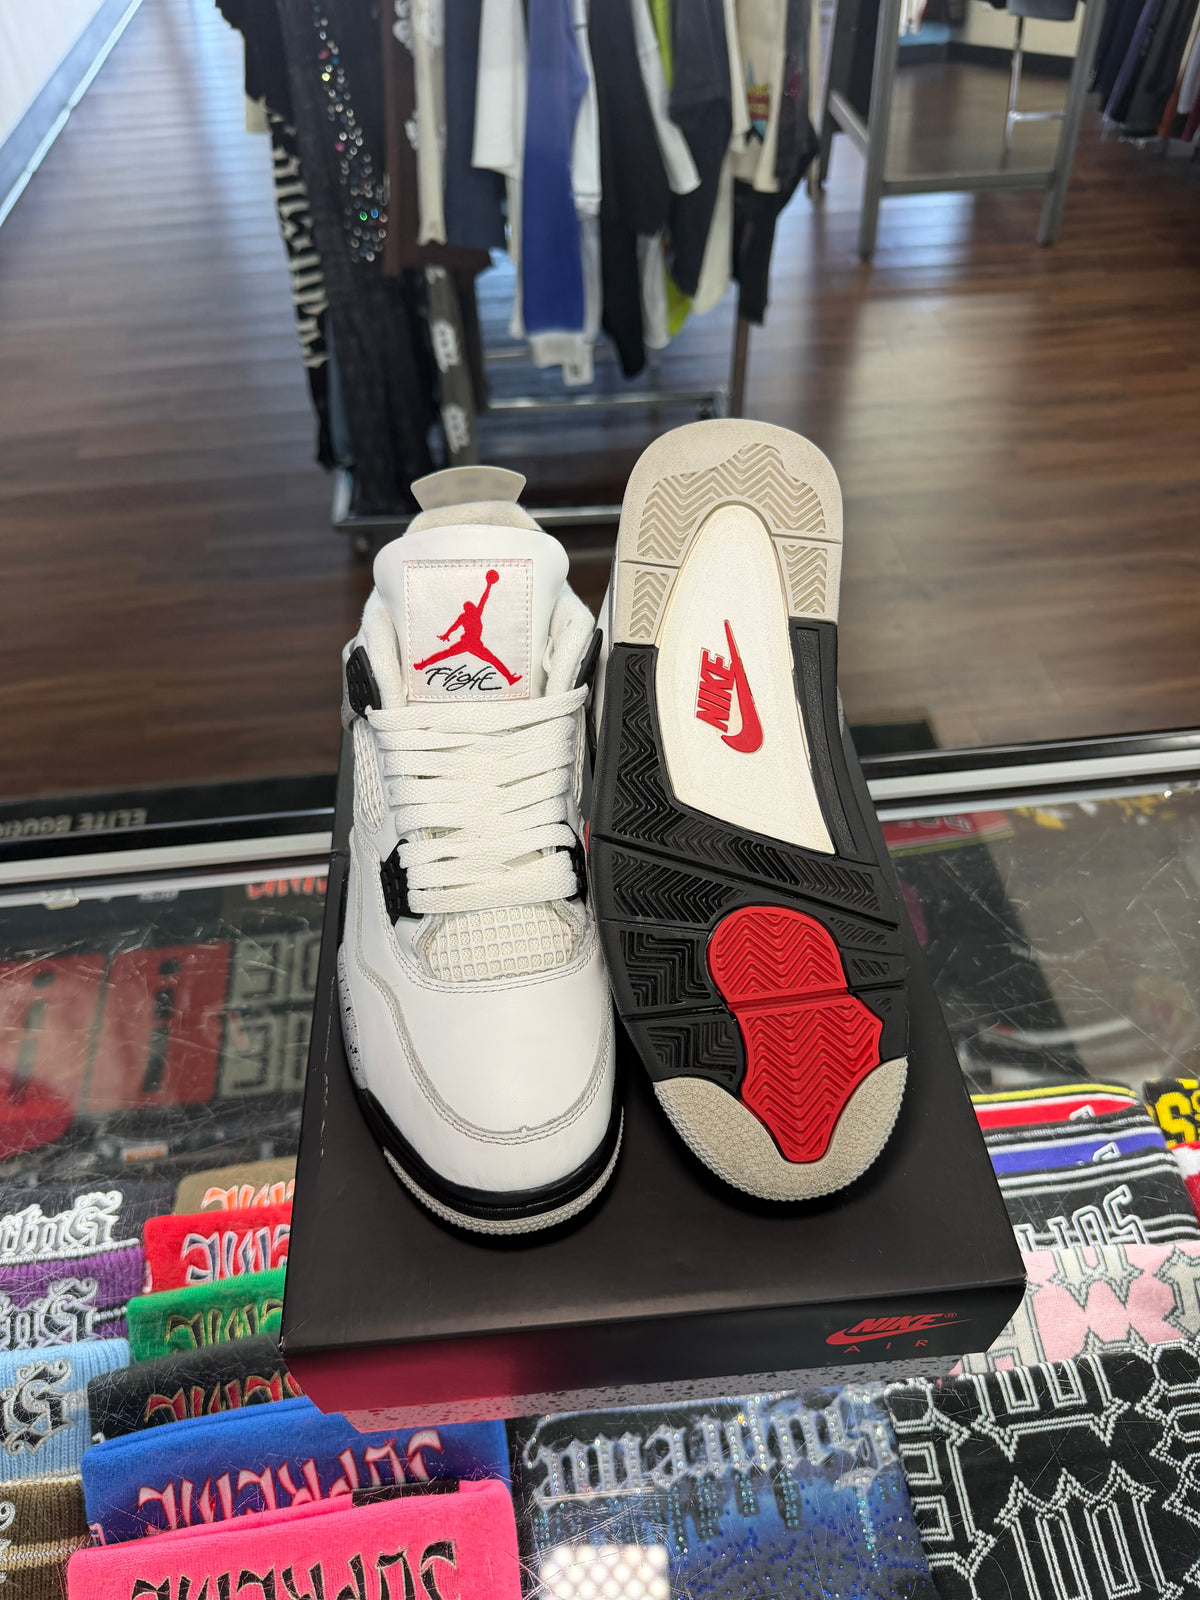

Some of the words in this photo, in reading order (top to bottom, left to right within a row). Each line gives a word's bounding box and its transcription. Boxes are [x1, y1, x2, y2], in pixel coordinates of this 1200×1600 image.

[425, 664, 502, 691] Flight
[695, 647, 735, 733] NIKE
[846, 1313, 944, 1333] NIKE
[843, 1340, 928, 1353] AIR
